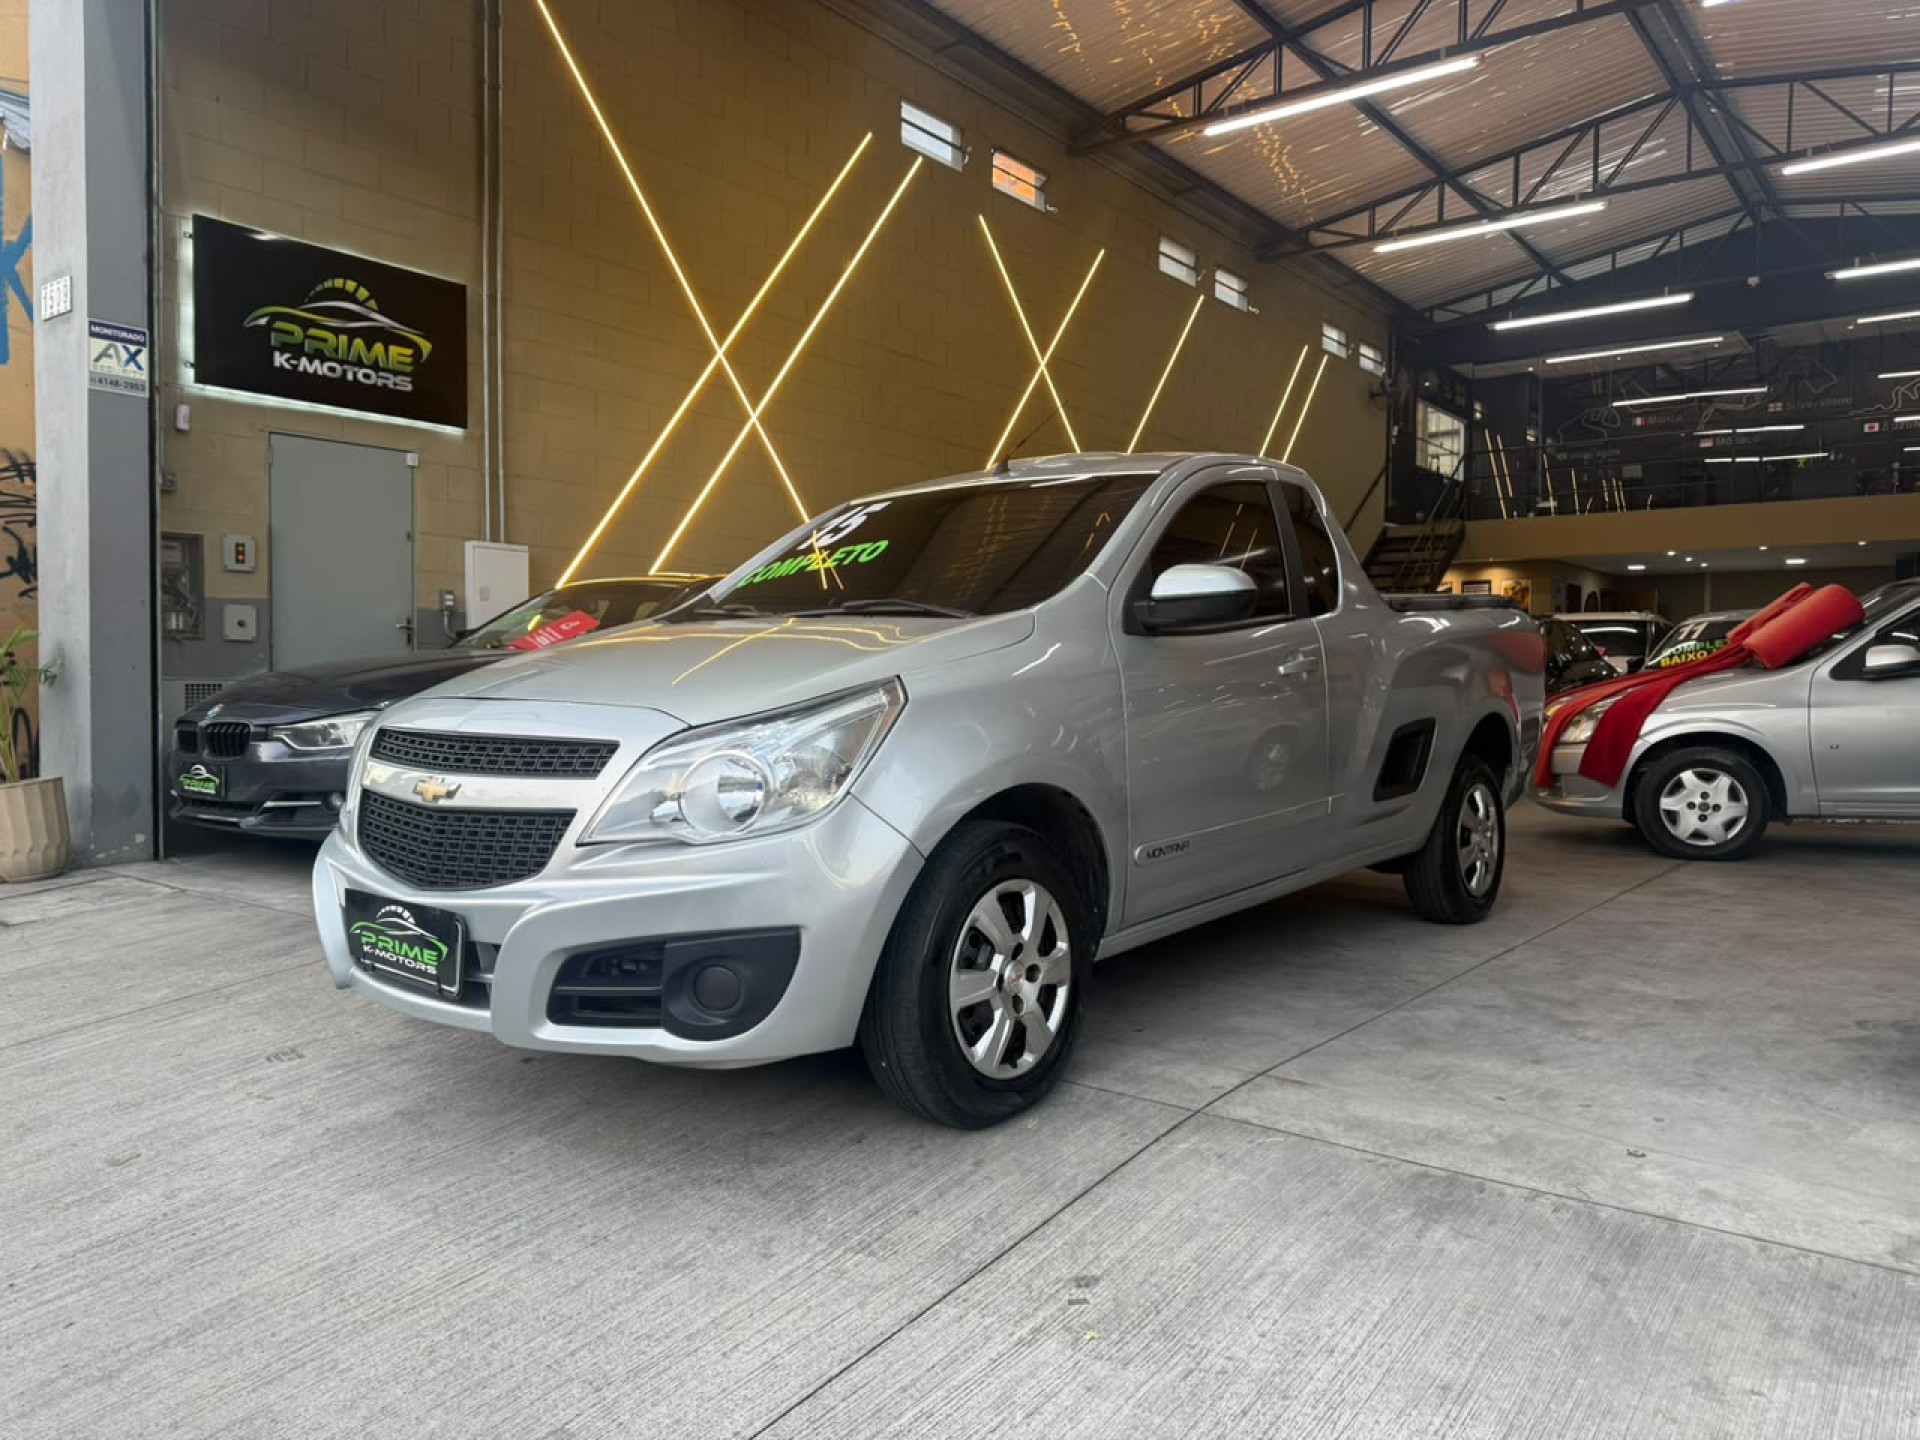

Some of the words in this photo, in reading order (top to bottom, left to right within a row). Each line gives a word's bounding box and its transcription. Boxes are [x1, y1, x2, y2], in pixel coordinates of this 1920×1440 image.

[91, 324, 145, 342] MONITORADO
[270, 321, 414, 373] PRIME
[93, 343, 144, 371] AX
[272, 350, 413, 392] K-MOTORS
[736, 539, 889, 589] COMPLETO
[1661, 639, 1728, 657] COMPLE
[1661, 650, 1708, 667] BAIXO
[361, 931, 439, 966] PRIME
[362, 944, 438, 975] K-MOTORS
